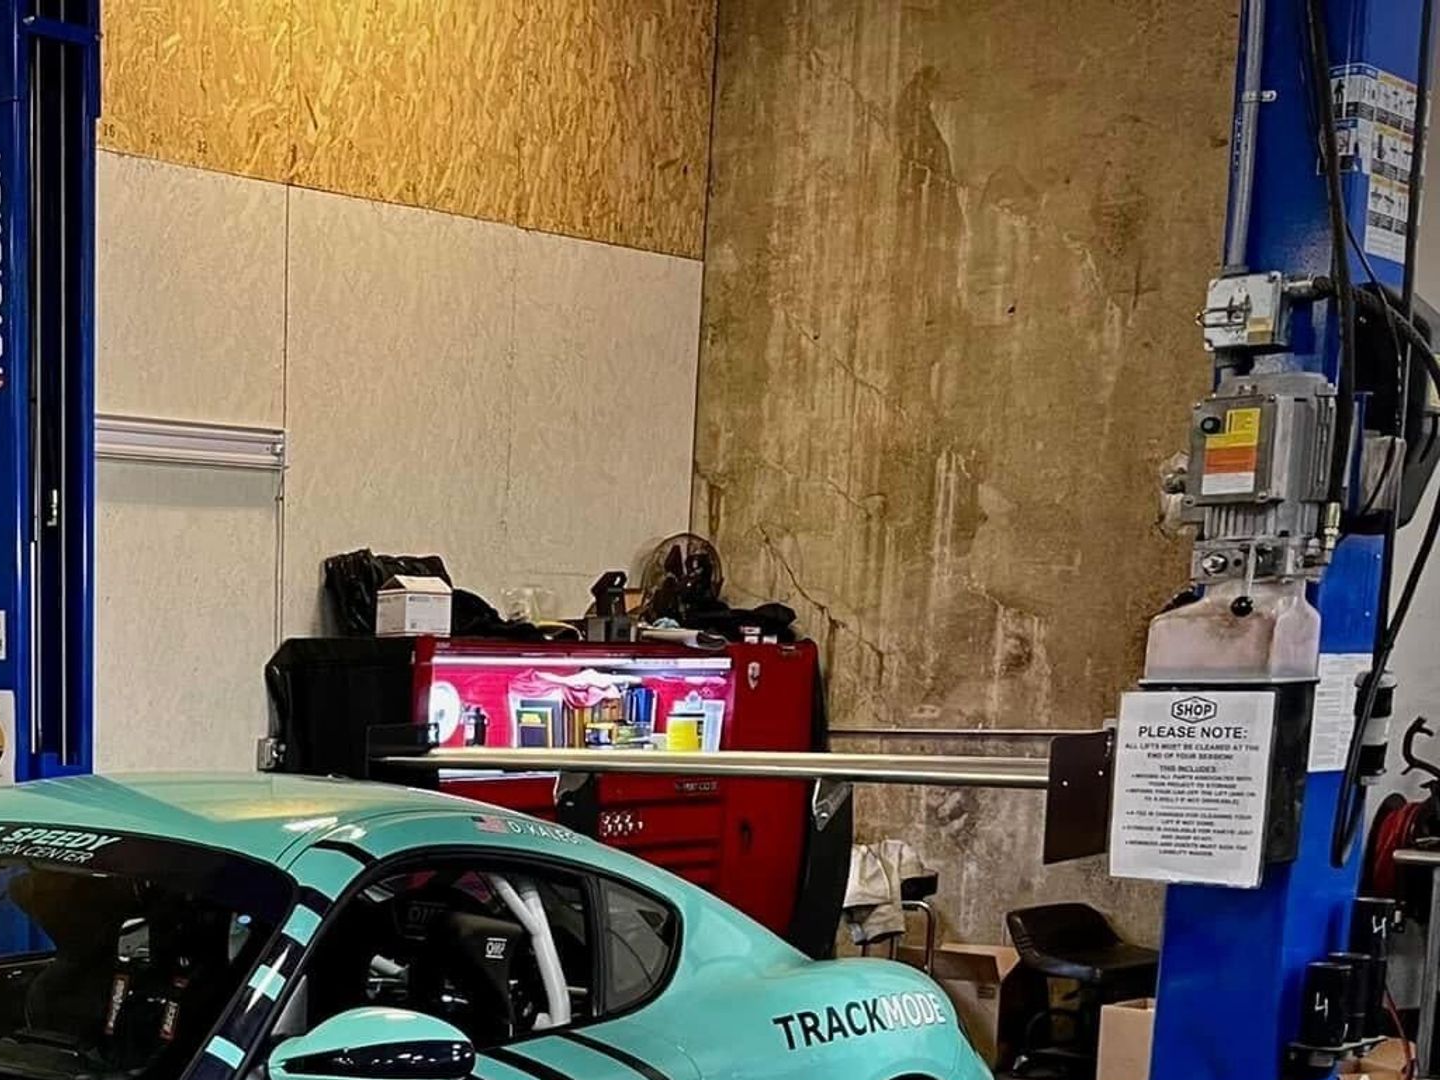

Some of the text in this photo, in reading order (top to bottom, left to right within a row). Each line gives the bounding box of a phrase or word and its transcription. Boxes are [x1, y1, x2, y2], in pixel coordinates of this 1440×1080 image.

[1175, 703, 1212, 716] SHOP
[1138, 726, 1249, 739] PLEASE NOTE:
[1, 827, 123, 851] SPEEDY
[23, 844, 95, 863] CENTER
[1372, 914, 1387, 939] 4
[1314, 991, 1329, 1021] 4
[772, 992, 947, 1051] TRACKMODE
